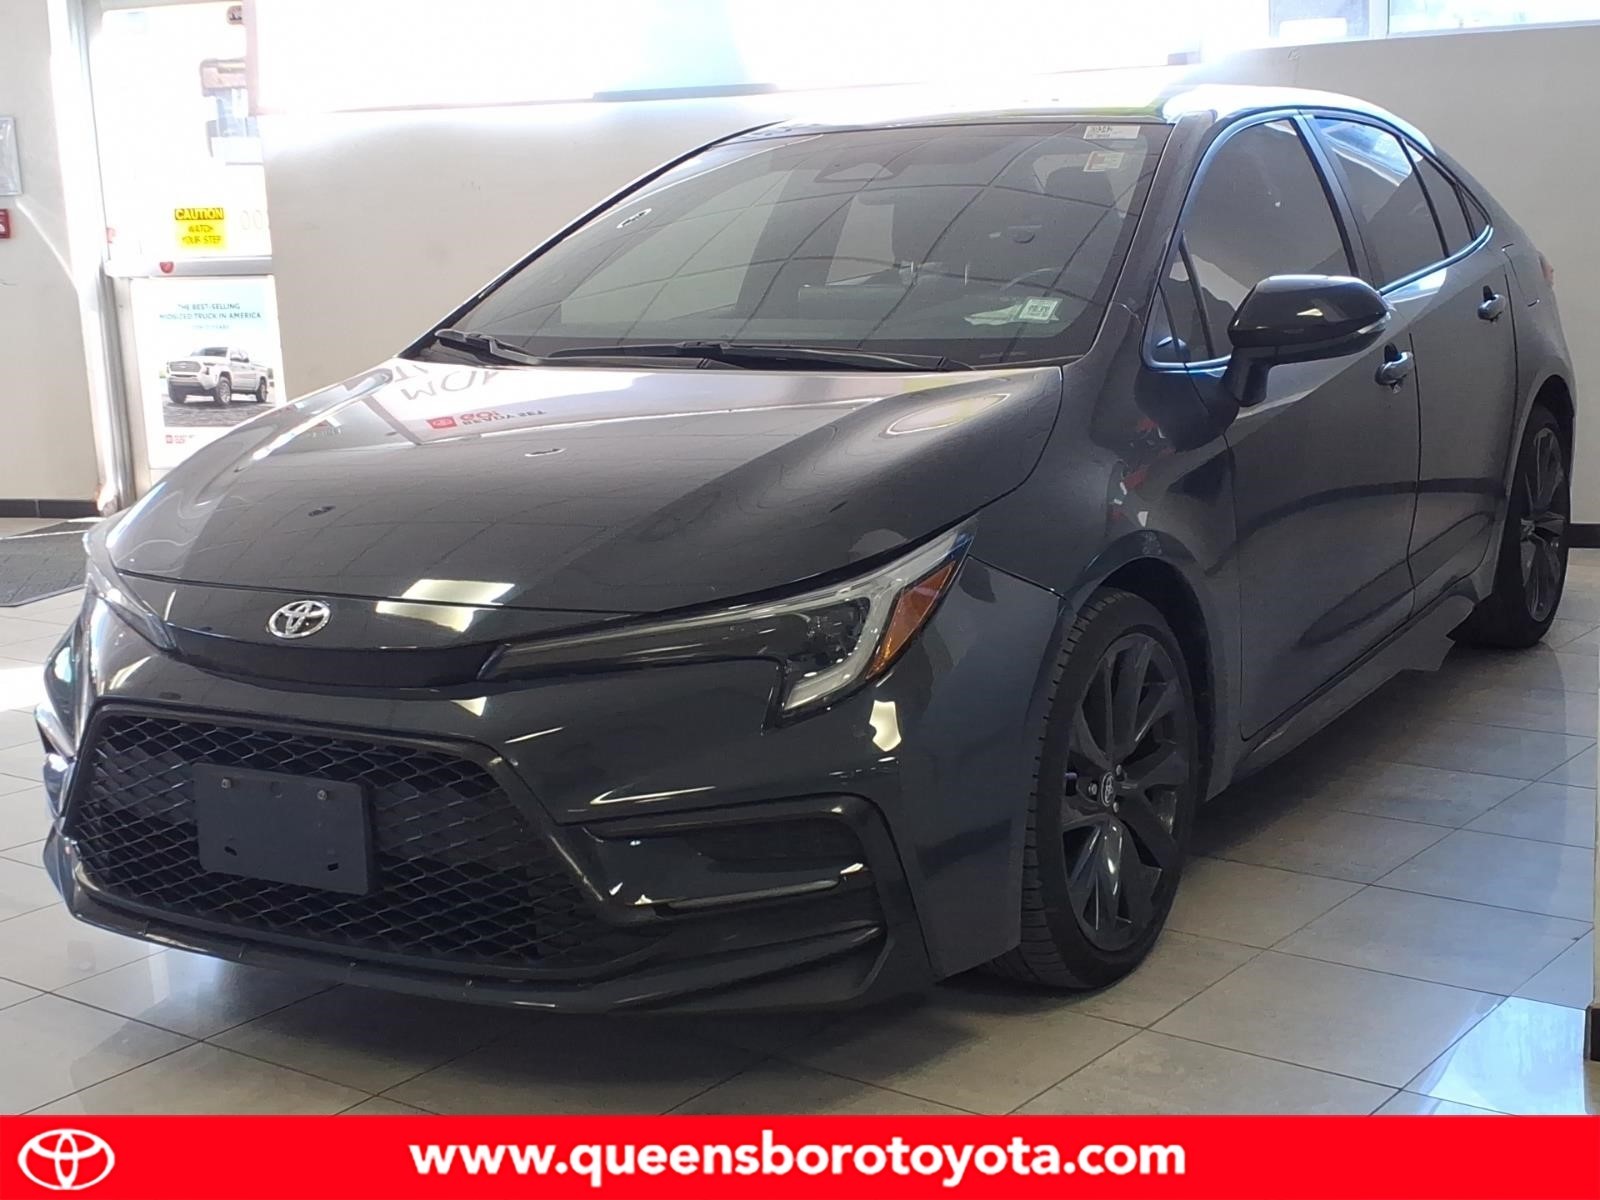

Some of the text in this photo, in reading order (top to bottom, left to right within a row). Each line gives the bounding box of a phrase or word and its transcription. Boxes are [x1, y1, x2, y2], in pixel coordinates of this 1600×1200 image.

[175, 208, 224, 220] CAUTION
[187, 224, 215, 233] WATCH
[181, 235, 222, 244] YOUR STEP
[177, 302, 241, 311] THE BEST-SELLING
[229, 311, 262, 319] AMERICA
